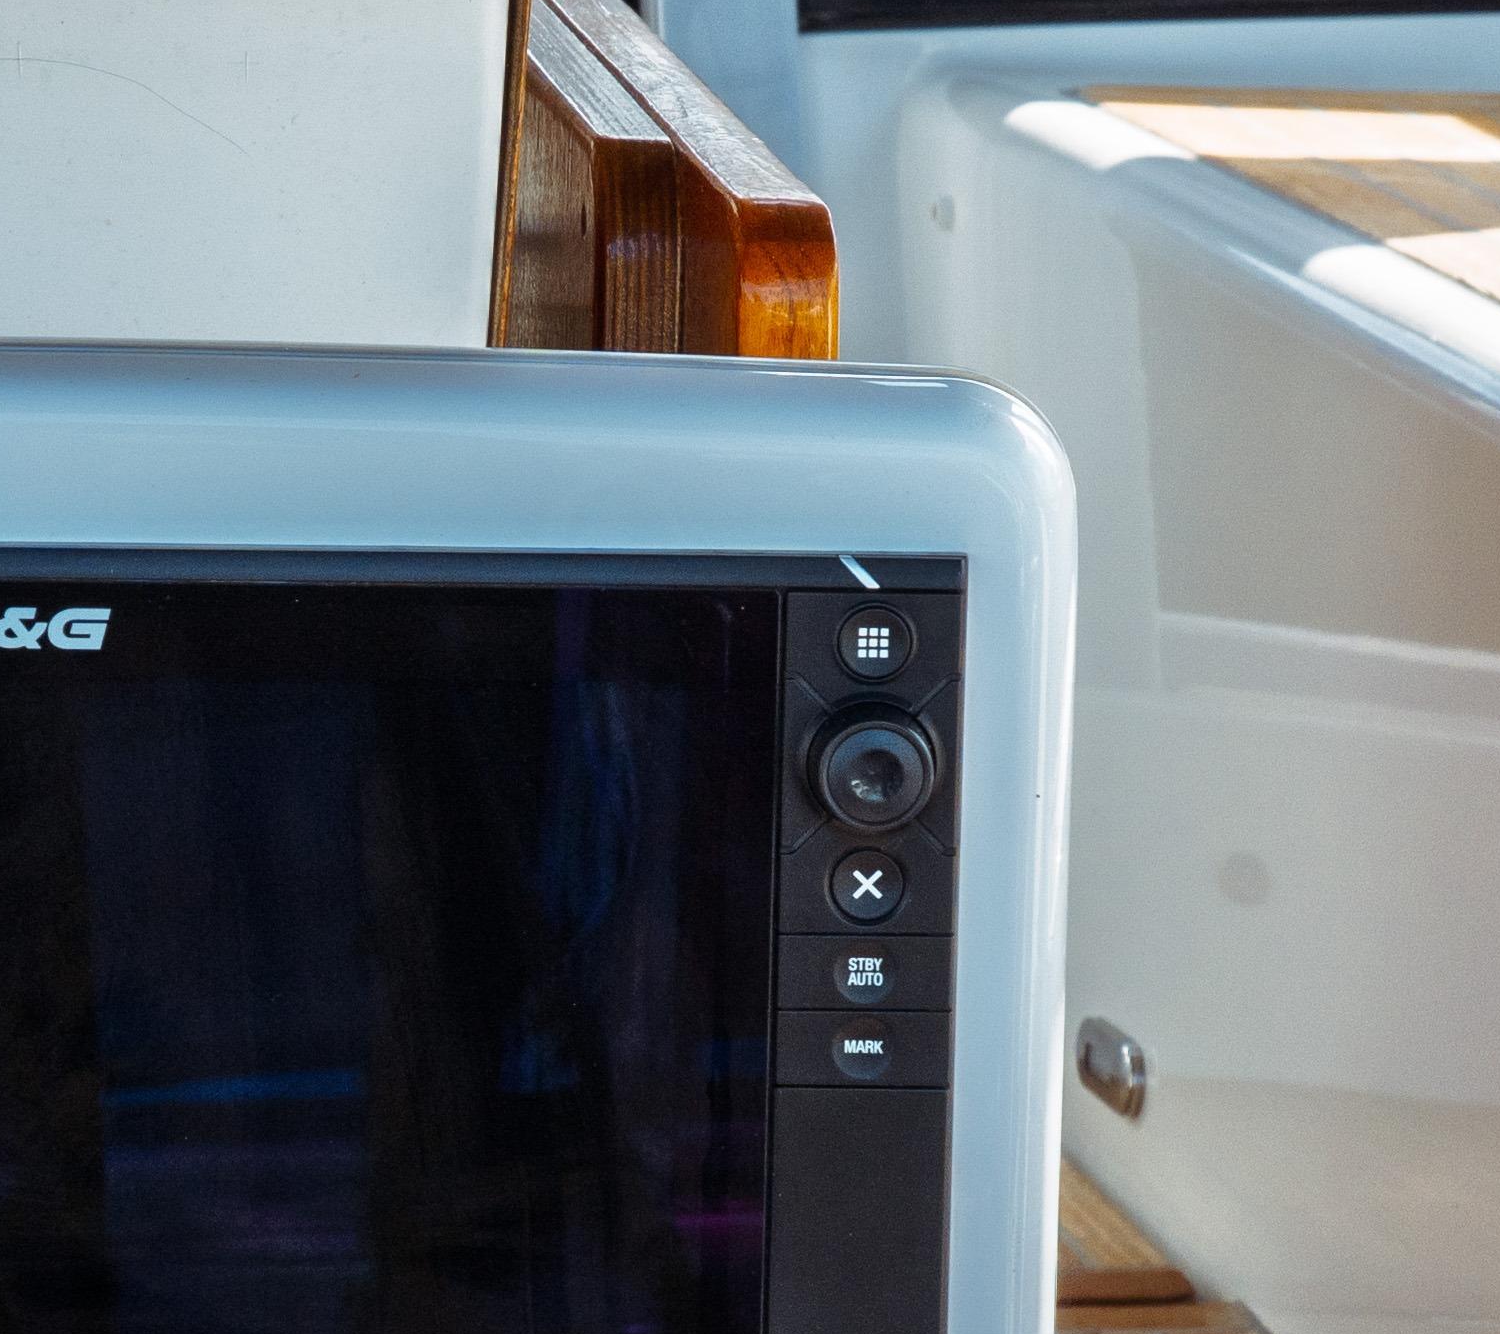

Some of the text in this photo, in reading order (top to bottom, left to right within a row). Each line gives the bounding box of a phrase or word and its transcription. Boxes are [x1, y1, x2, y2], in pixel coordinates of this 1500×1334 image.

[847, 957, 883, 971] STBY
[847, 972, 884, 986] AUTO
[843, 1039, 884, 1054] MARK
